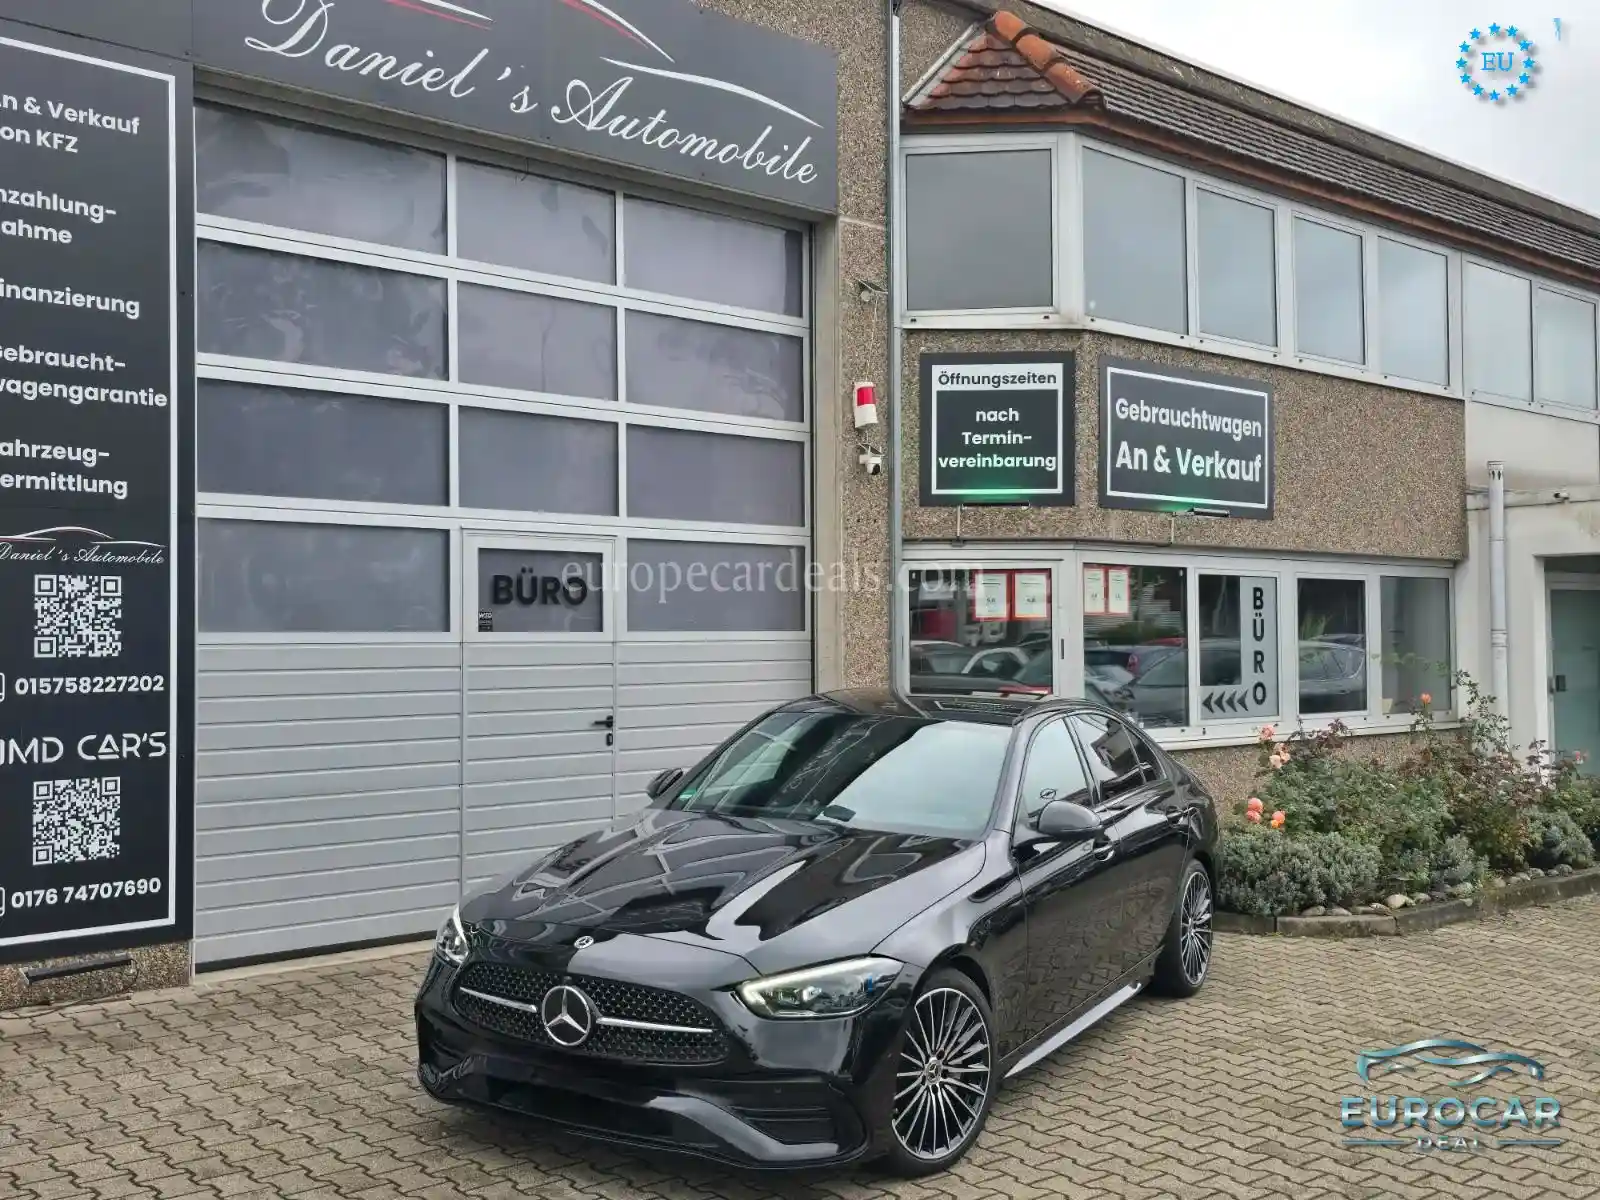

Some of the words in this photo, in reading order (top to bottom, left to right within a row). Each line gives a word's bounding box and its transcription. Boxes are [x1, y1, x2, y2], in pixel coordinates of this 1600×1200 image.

[0, 94, 18, 111] n
[23, 96, 42, 115] &
[47, 100, 140, 135] Verkauf
[36, 129, 78, 153] KFZ
[551, 75, 818, 185] Automobile
[0, 345, 126, 372] ebraucht-
[938, 371, 1057, 388] Öffnungszeiten
[975, 408, 1020, 422] nach
[1115, 397, 1262, 442] Gebrauchtwagen
[961, 430, 1033, 445] Termin-
[938, 454, 1057, 471] vereinbarung
[1115, 440, 1148, 471] An
[1153, 444, 1172, 474] &
[1175, 447, 1262, 482] Verkauf
[74, 545, 165, 564] Automobile
[491, 567, 588, 606] BÜRO
[1252, 586, 1267, 706] BÜRO
[15, 675, 164, 695] 015758227202
[77, 731, 167, 761] CAR'S
[11, 889, 58, 908] 0176
[62, 878, 161, 904] 74707690
